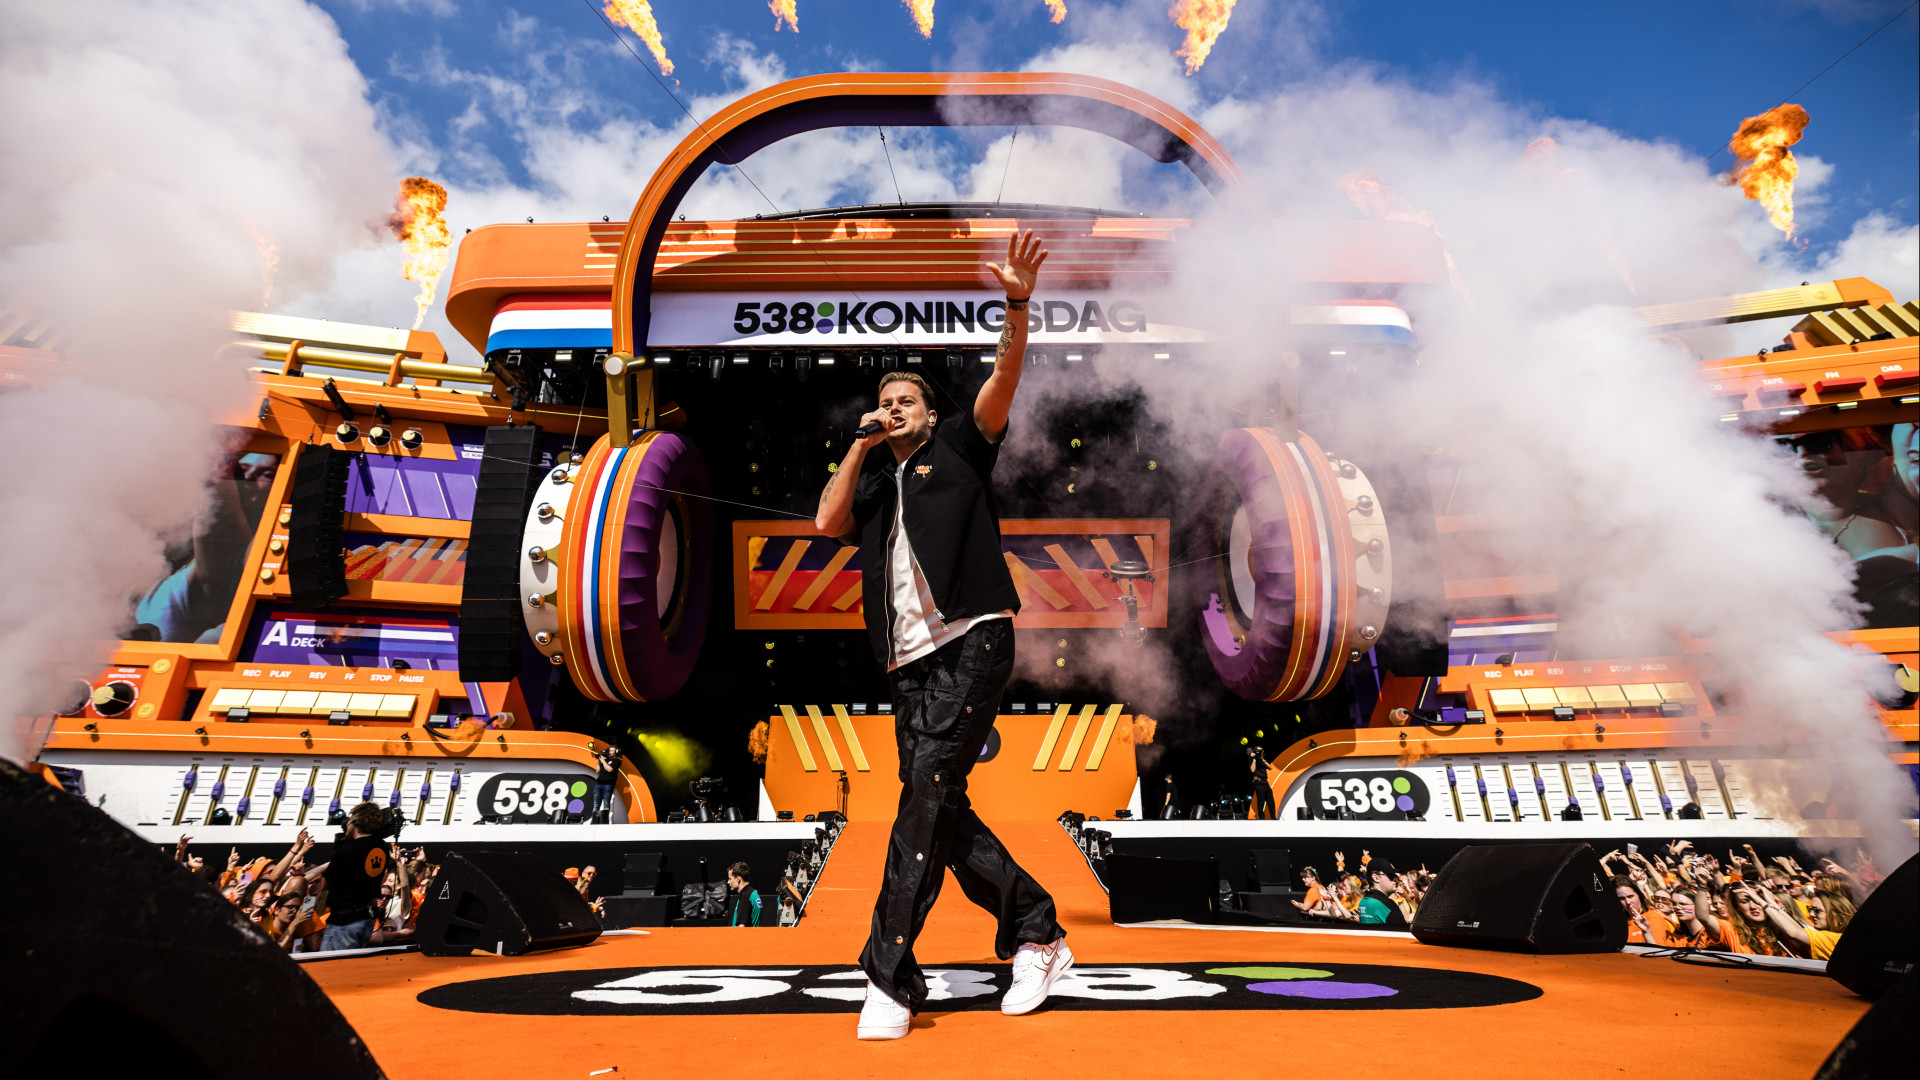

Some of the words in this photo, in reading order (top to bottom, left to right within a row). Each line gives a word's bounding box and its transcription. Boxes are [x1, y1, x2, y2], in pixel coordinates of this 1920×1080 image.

[1761, 377, 1784, 386] TAPE
[1825, 371, 1840, 379] FM
[1880, 365, 1903, 373] DAB
[261, 621, 288, 646] A
[290, 637, 325, 648] DECK
[242, 669, 262, 677] REC
[269, 670, 292, 678] PLAY
[309, 672, 327, 680] REV
[370, 674, 392, 682] STOP
[399, 675, 425, 683] PAUSE
[1484, 670, 1502, 678] REC
[1514, 669, 1534, 677] PLAY
[1583, 666, 1593, 674] FF
[1609, 665, 1632, 673] STOP
[493, 780, 569, 815] 538
[1321, 777, 1396, 813] 538
